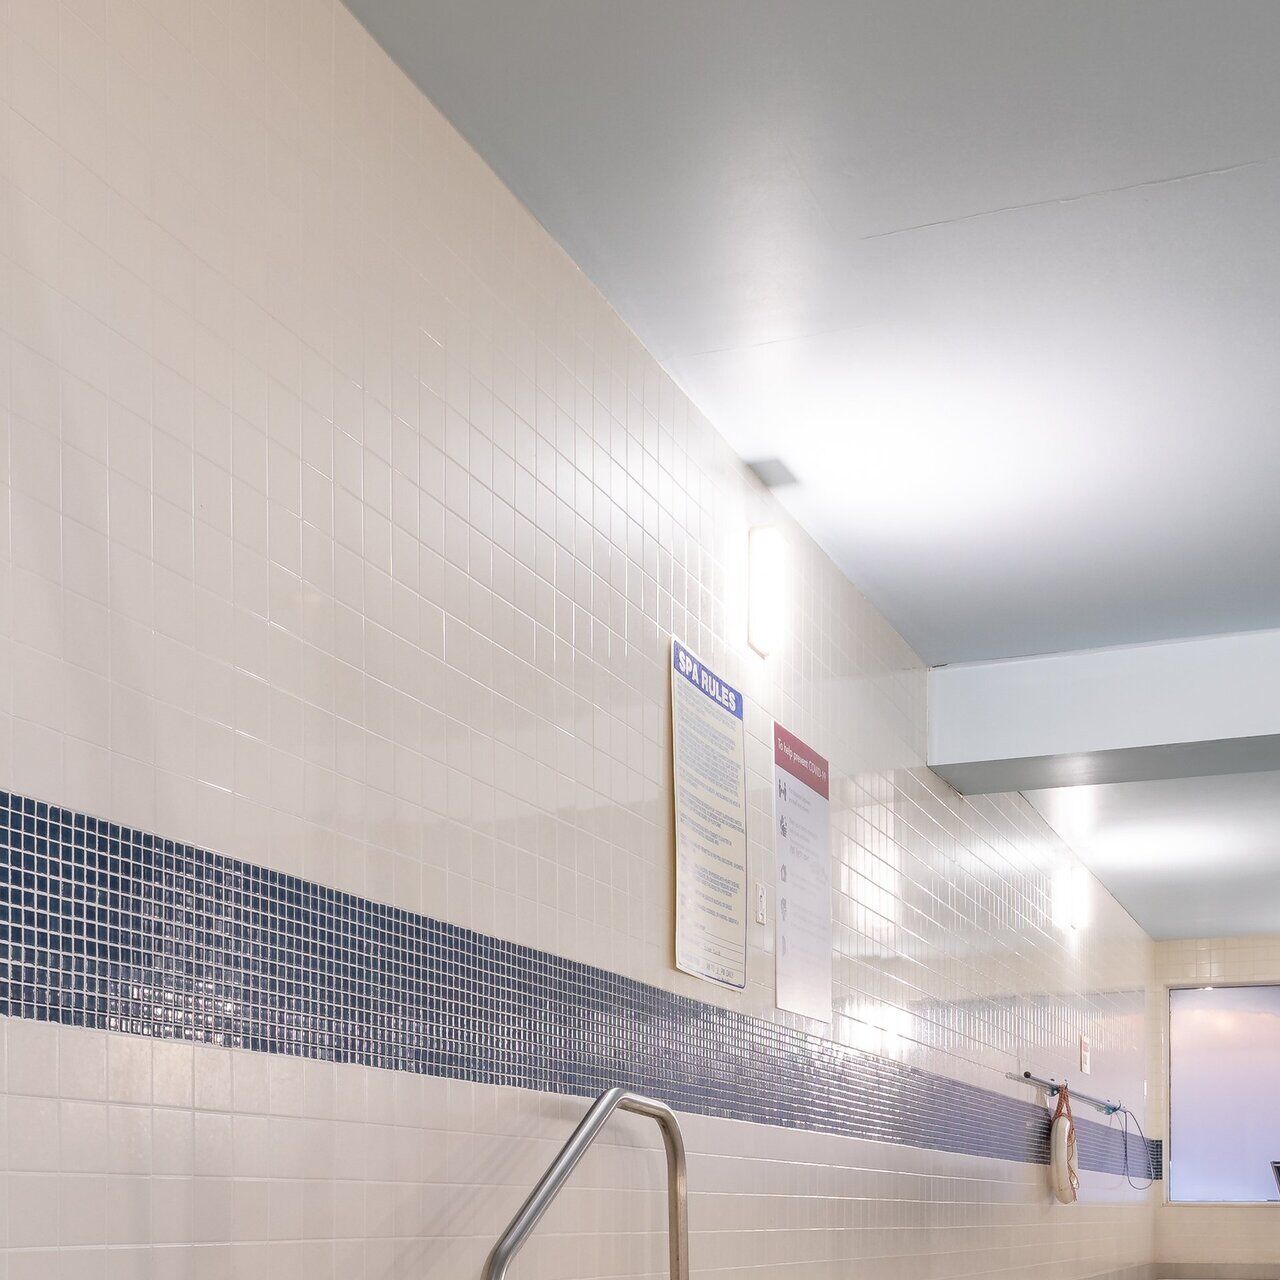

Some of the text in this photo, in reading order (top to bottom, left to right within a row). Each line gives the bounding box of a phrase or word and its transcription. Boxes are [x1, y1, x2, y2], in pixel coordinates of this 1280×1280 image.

[679, 650, 736, 711] SPA RULES
[777, 737, 783, 751] To
[783, 742, 793, 760] help
[793, 752, 809, 770] prevent
